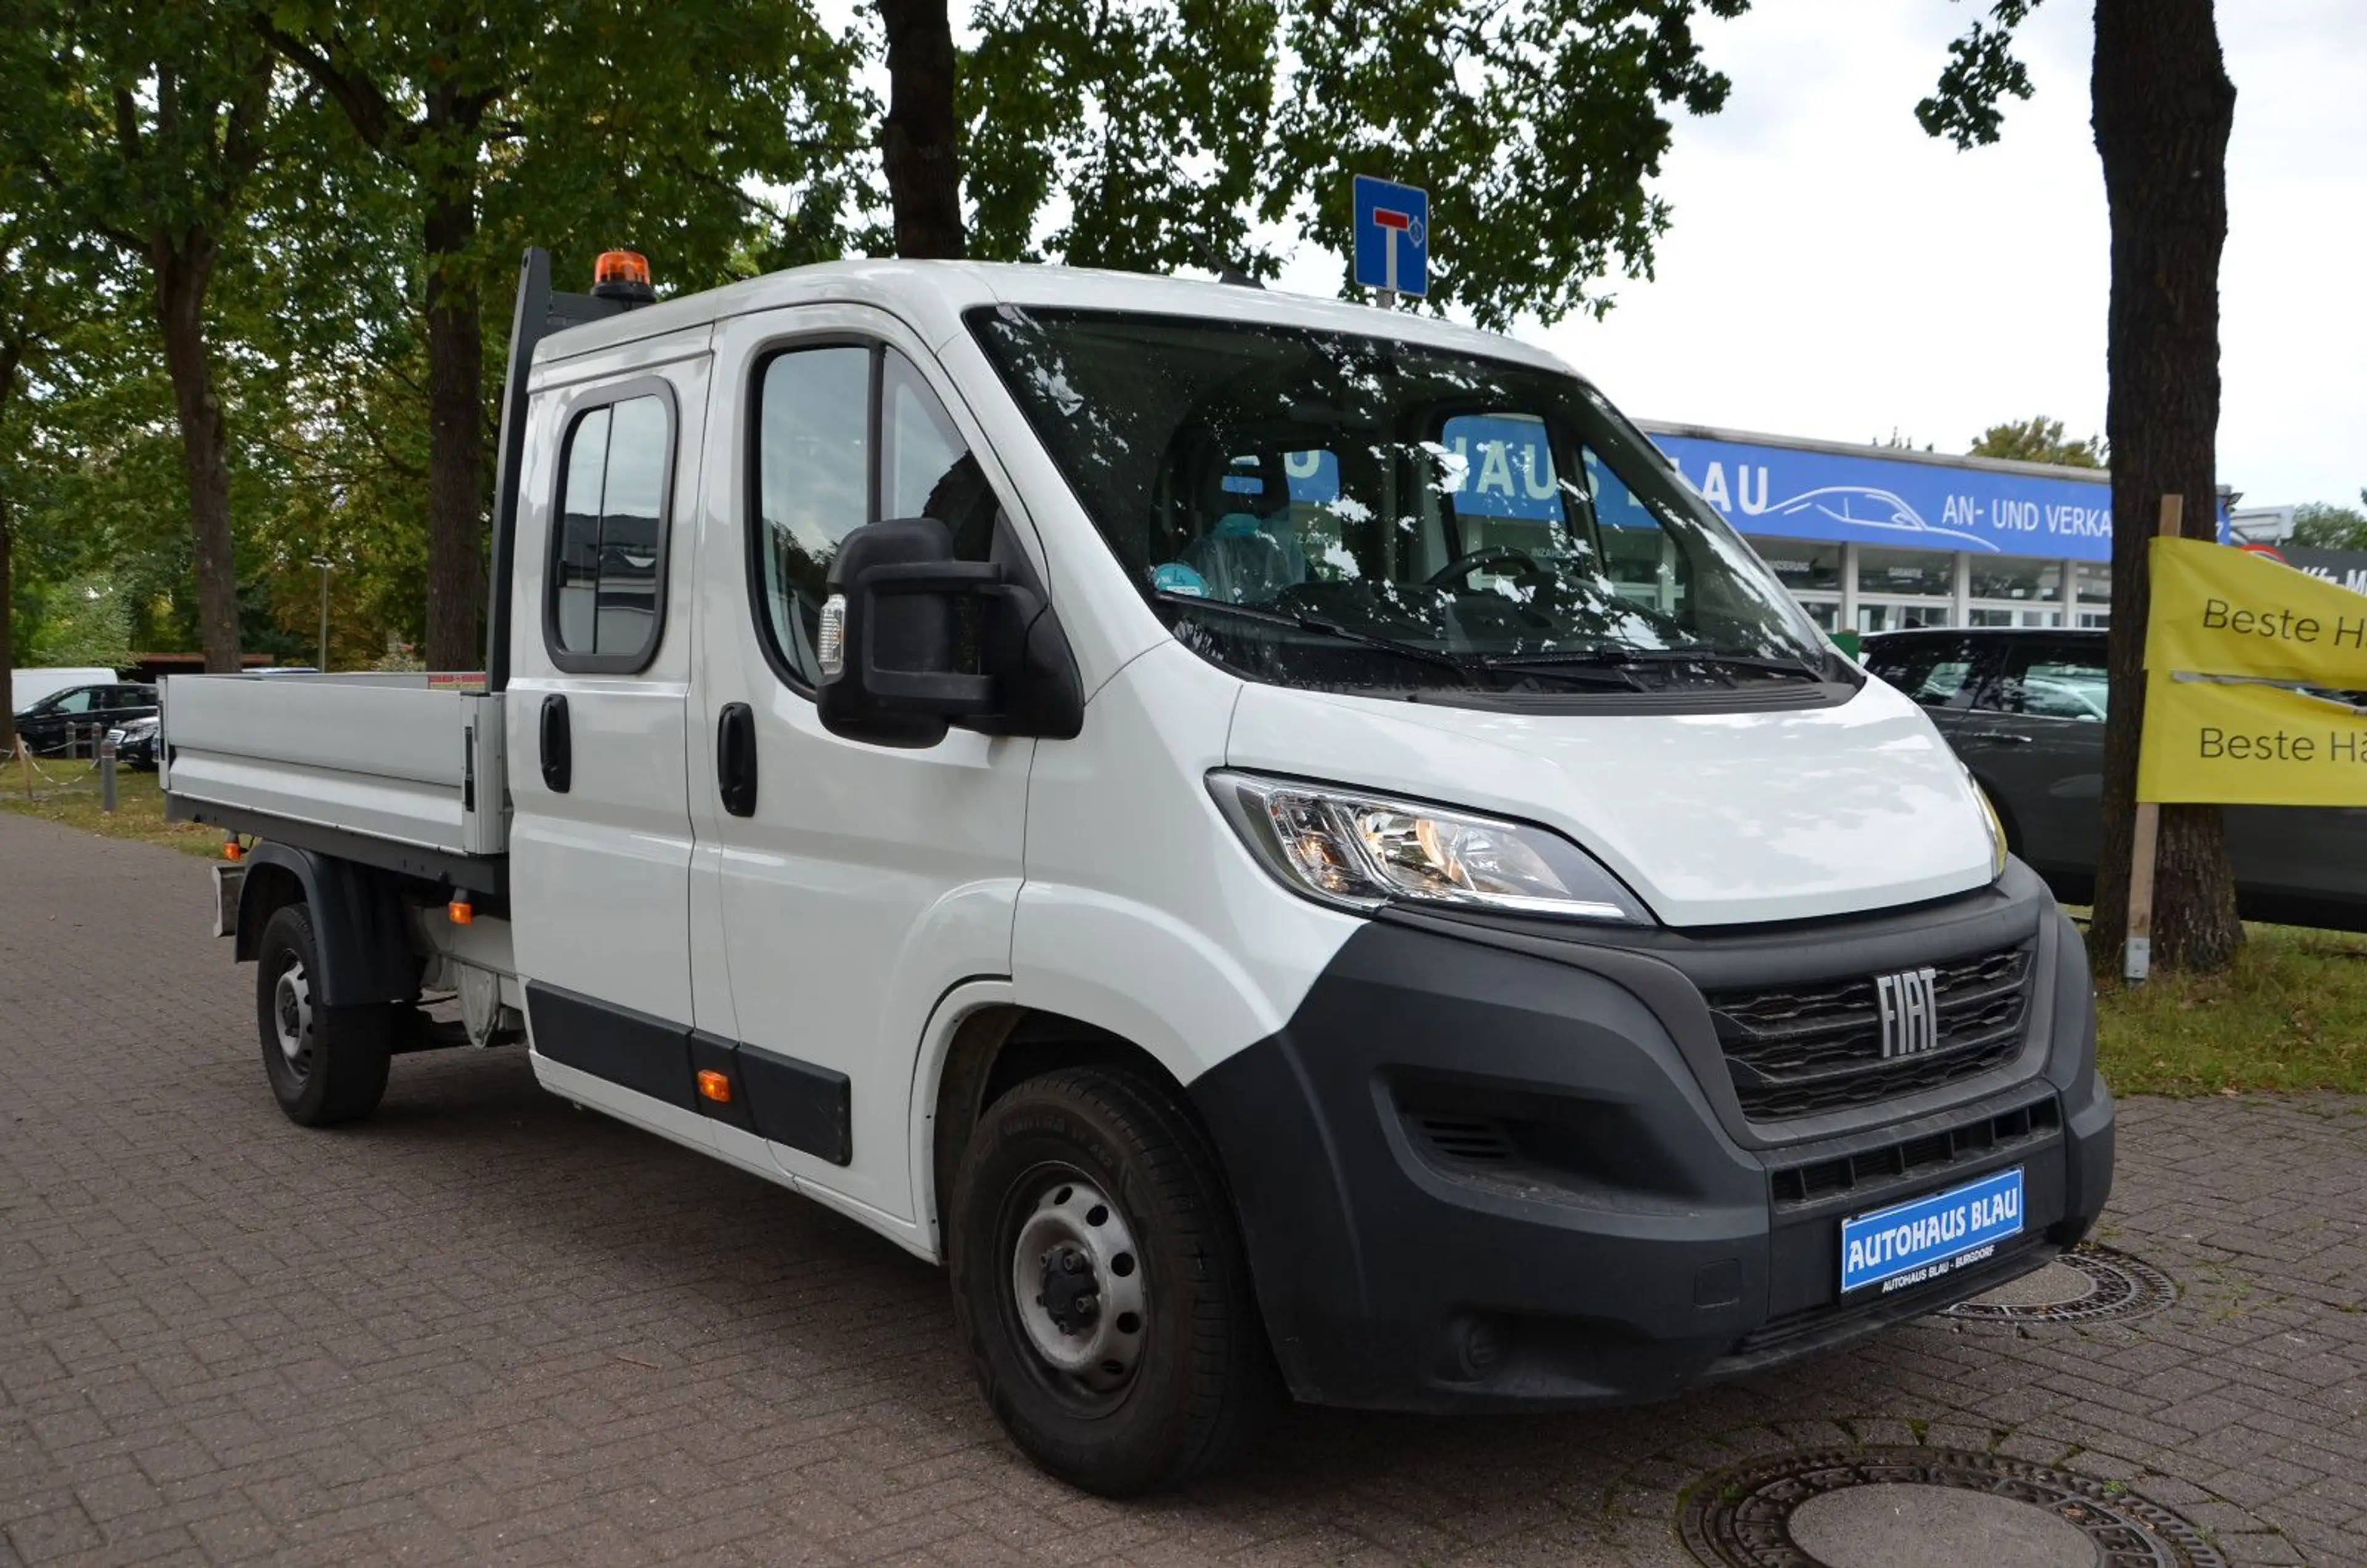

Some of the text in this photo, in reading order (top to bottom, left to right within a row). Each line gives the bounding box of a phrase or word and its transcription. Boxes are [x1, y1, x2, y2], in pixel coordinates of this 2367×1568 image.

[1669, 457, 1768, 517] AU
[1942, 494, 2112, 537] AN- UND VERKA
[2203, 598, 2367, 648] Beste H
[2200, 727, 2315, 761] Beste
[1878, 968, 1937, 1058] FIAT
[1847, 1188, 2017, 1273] AUTOHAUS BLAU
[1882, 1270, 1927, 1293] AUTOHAUS
[1928, 1262, 1949, 1280] BLAU
[1955, 1245, 1995, 1268] BURGDORF
